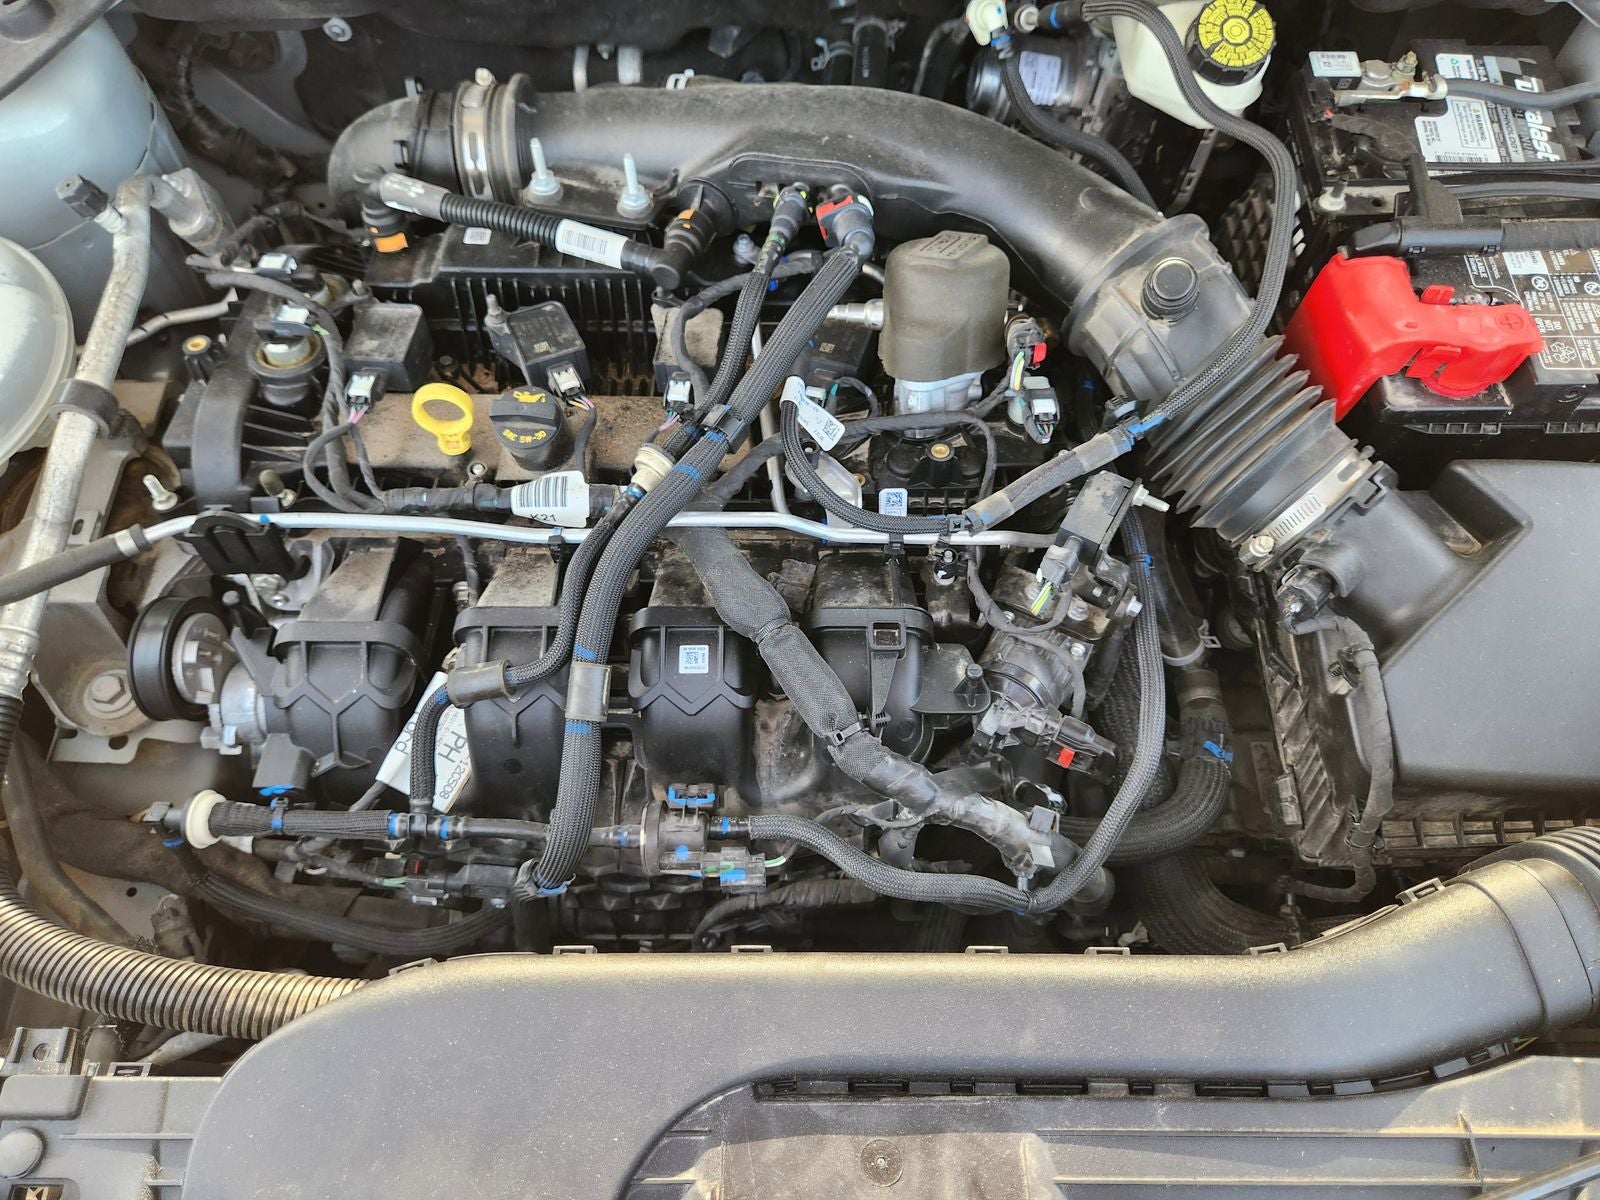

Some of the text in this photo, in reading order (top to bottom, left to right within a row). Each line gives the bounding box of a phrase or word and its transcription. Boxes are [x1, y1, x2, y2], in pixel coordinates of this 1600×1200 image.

[1475, 114, 1487, 142] WARNING:
[1514, 77, 1561, 162] Dalast
[1535, 318, 1546, 334] OPEN.
[1544, 320, 1554, 331] NOT
[1553, 321, 1562, 330] DO
[502, 429, 547, 444] SAE 5W-30
[394, 719, 417, 755] ord
[438, 730, 467, 763] PH
